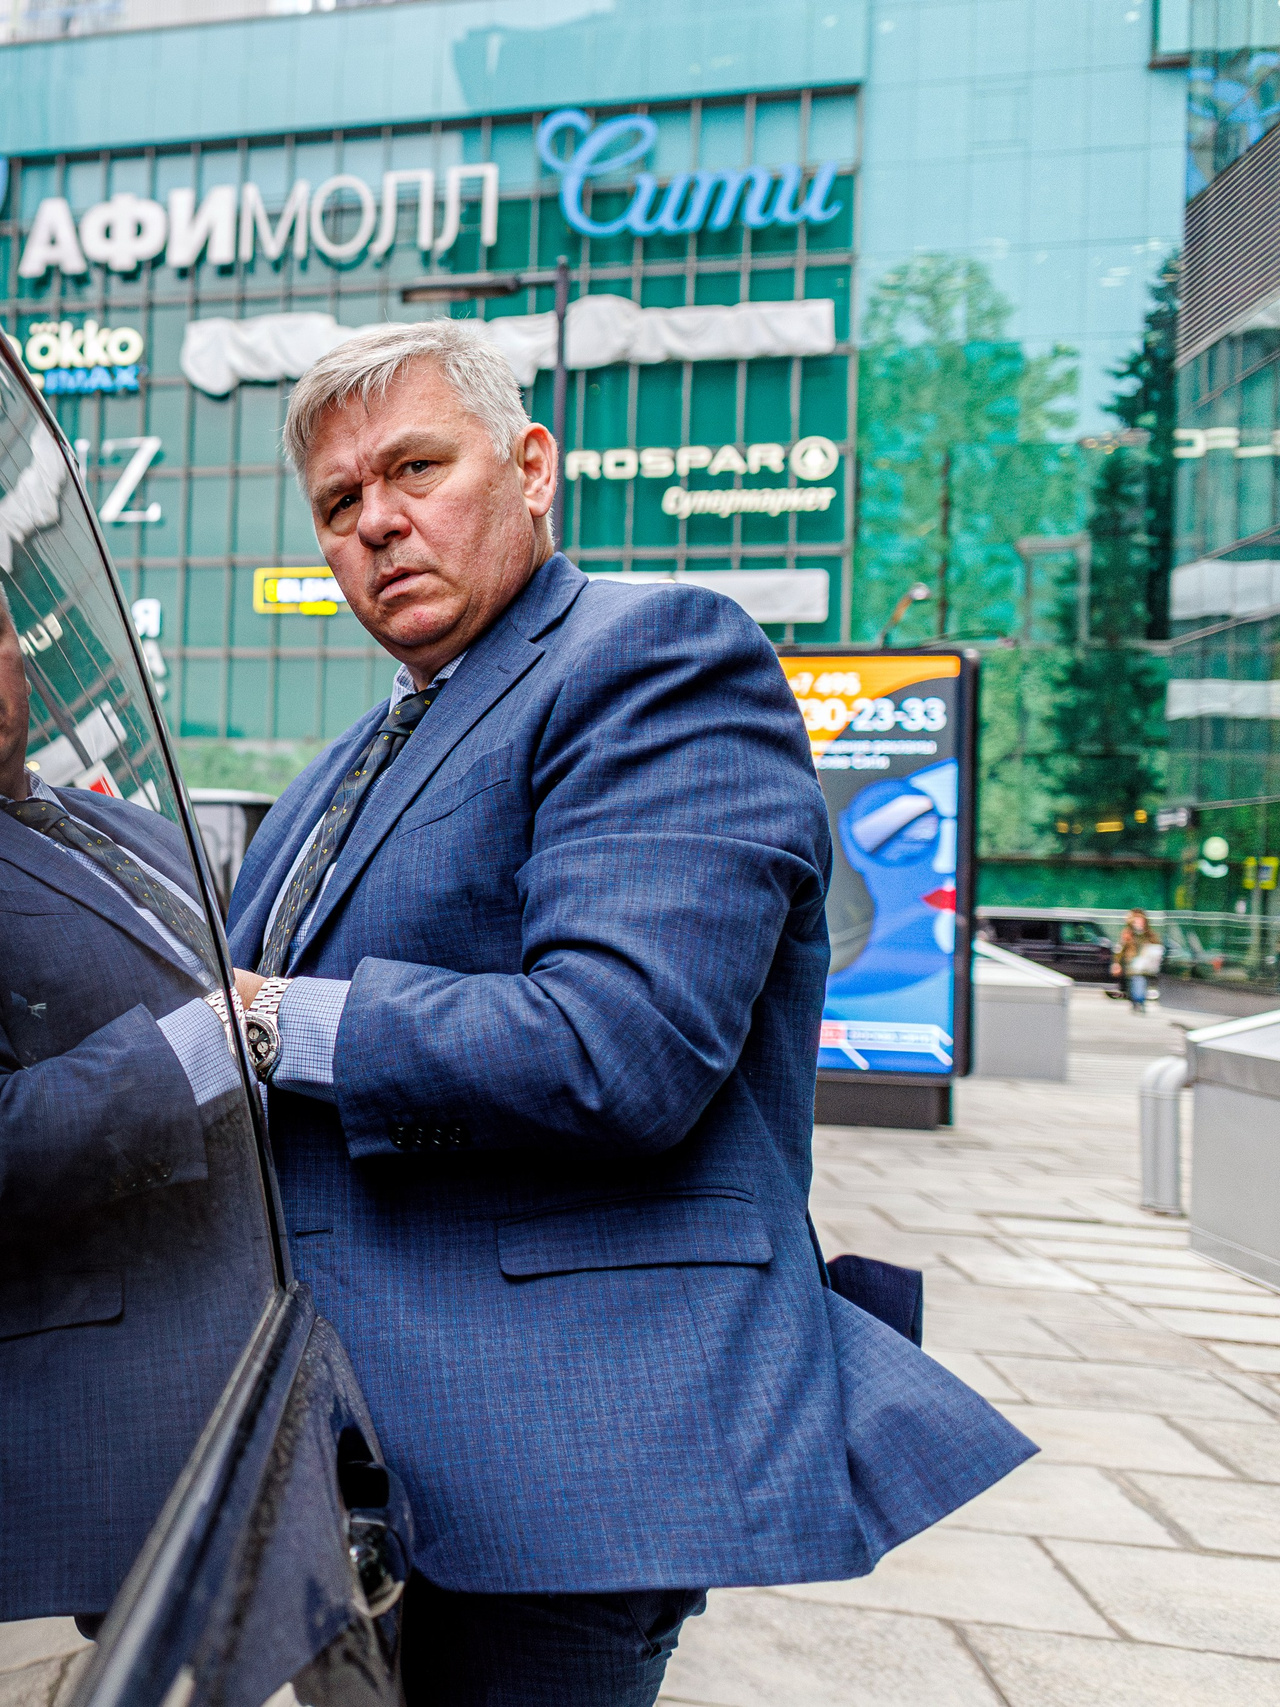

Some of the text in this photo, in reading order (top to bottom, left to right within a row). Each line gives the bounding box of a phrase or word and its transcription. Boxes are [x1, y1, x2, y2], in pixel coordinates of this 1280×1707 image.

[19, 108, 843, 278] АФИМОЛЛ Сити
[565, 442, 785, 481] ROSPAR
